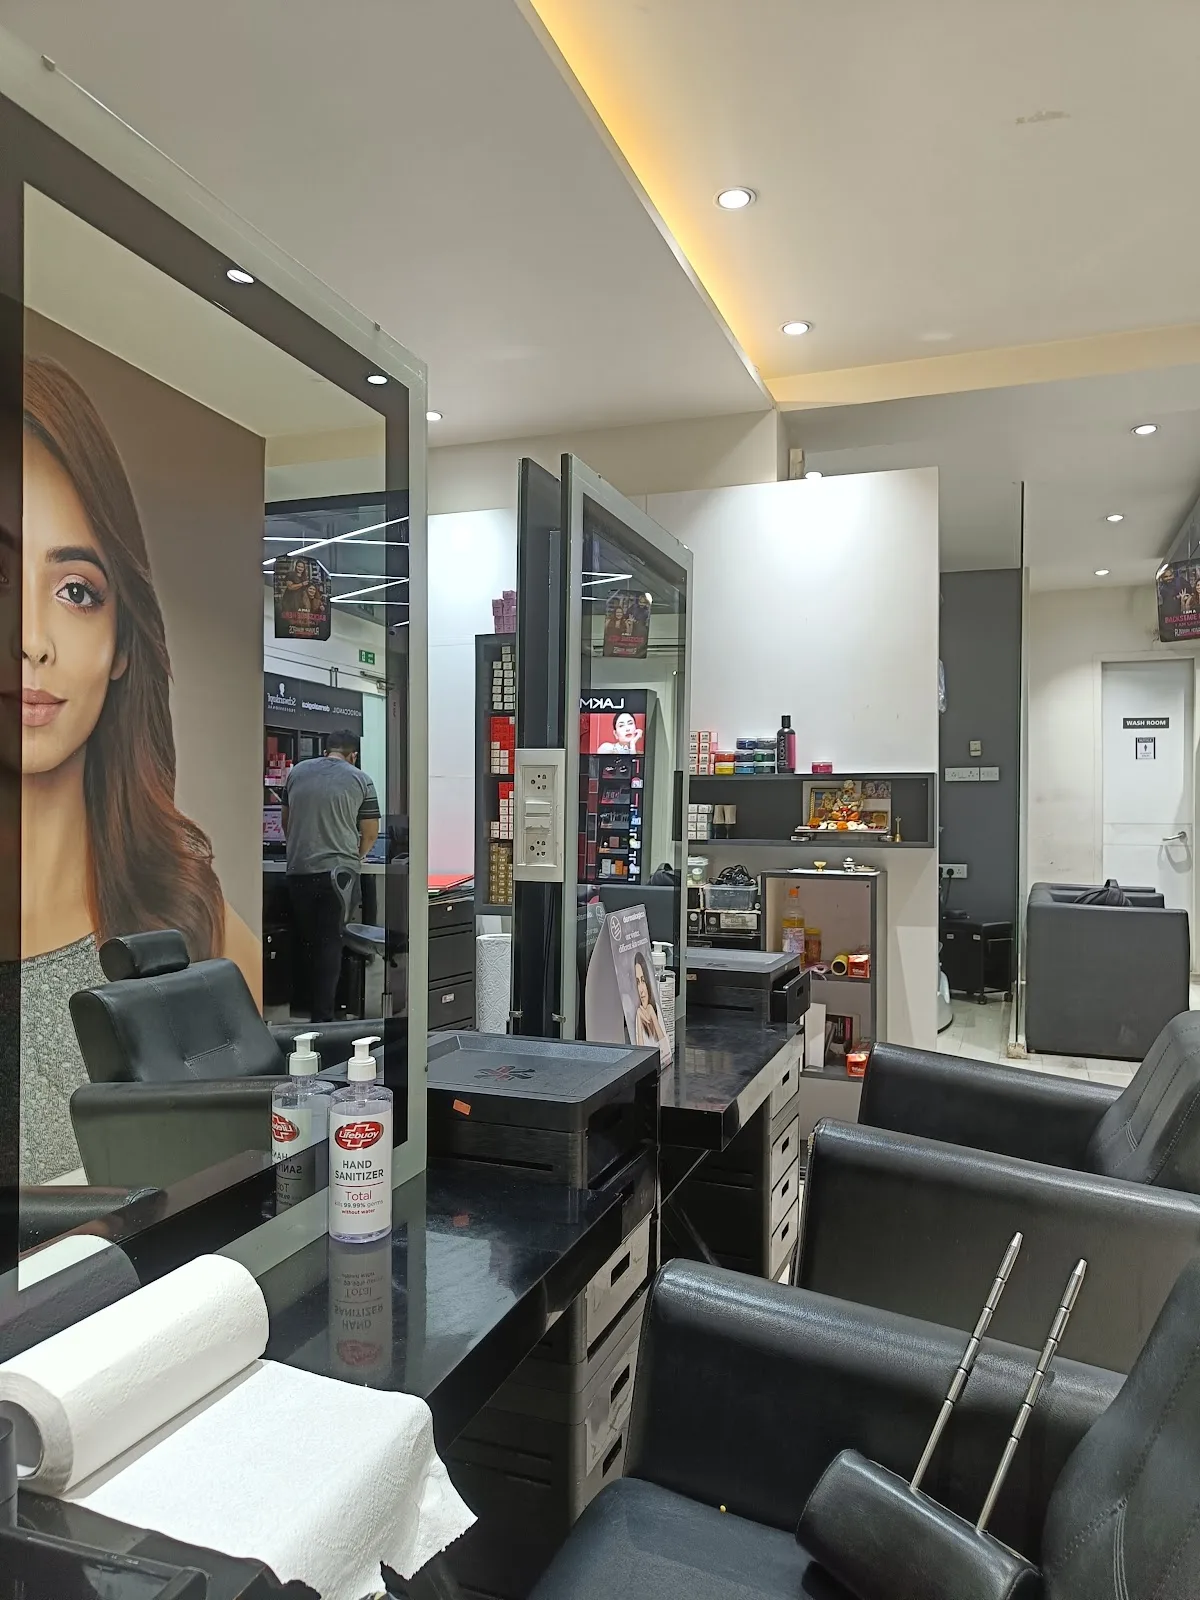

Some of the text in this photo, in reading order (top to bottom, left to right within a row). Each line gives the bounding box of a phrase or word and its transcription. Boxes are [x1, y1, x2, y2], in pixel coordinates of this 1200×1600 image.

[338, 1130, 380, 1140] Lifebuoy
[342, 1160, 372, 1169] HAND
[334, 1168, 384, 1181] SANITIZER
[345, 1190, 372, 1201] Total
[366, 1199, 384, 1208] germs
